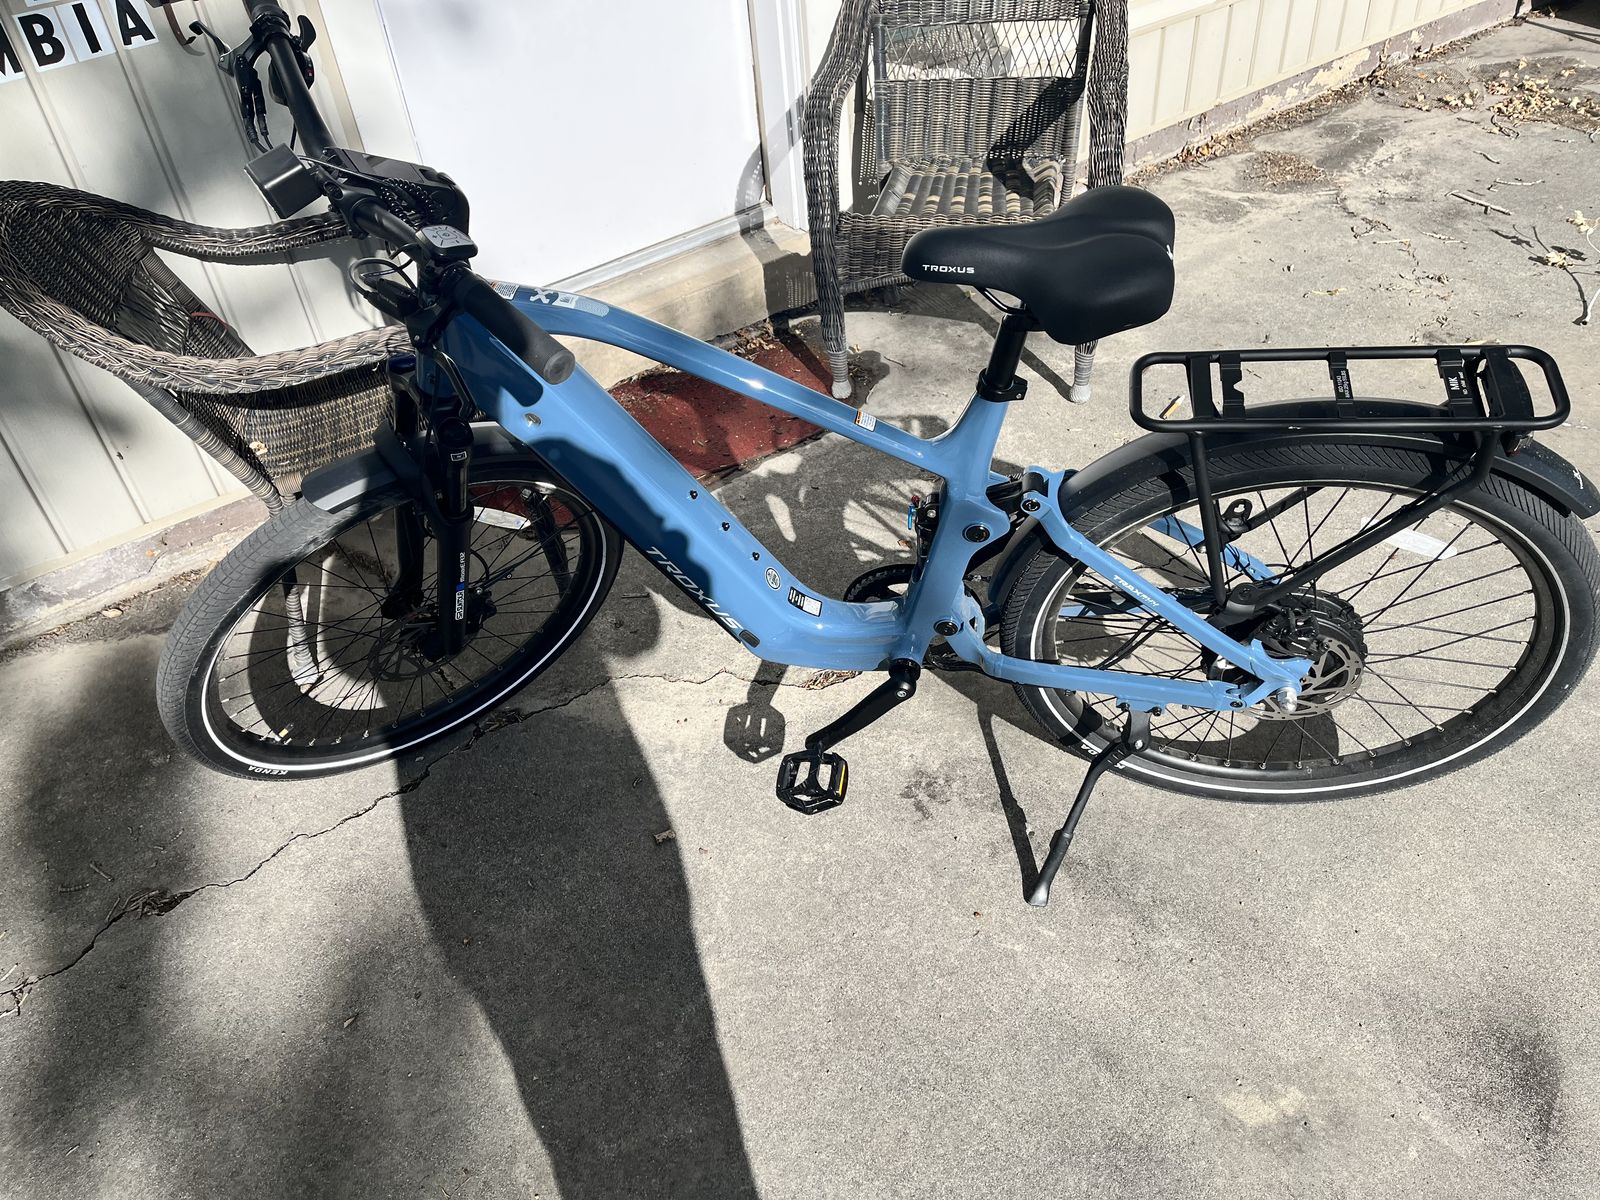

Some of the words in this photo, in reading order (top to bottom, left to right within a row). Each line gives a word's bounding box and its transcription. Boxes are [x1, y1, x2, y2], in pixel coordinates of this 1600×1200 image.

[922, 264, 975, 274] TROXUS
[1448, 376, 1460, 391] MIK
[645, 546, 744, 630] TROXUS
[1081, 743, 1126, 769] KDA
[248, 765, 289, 777] KENDA
